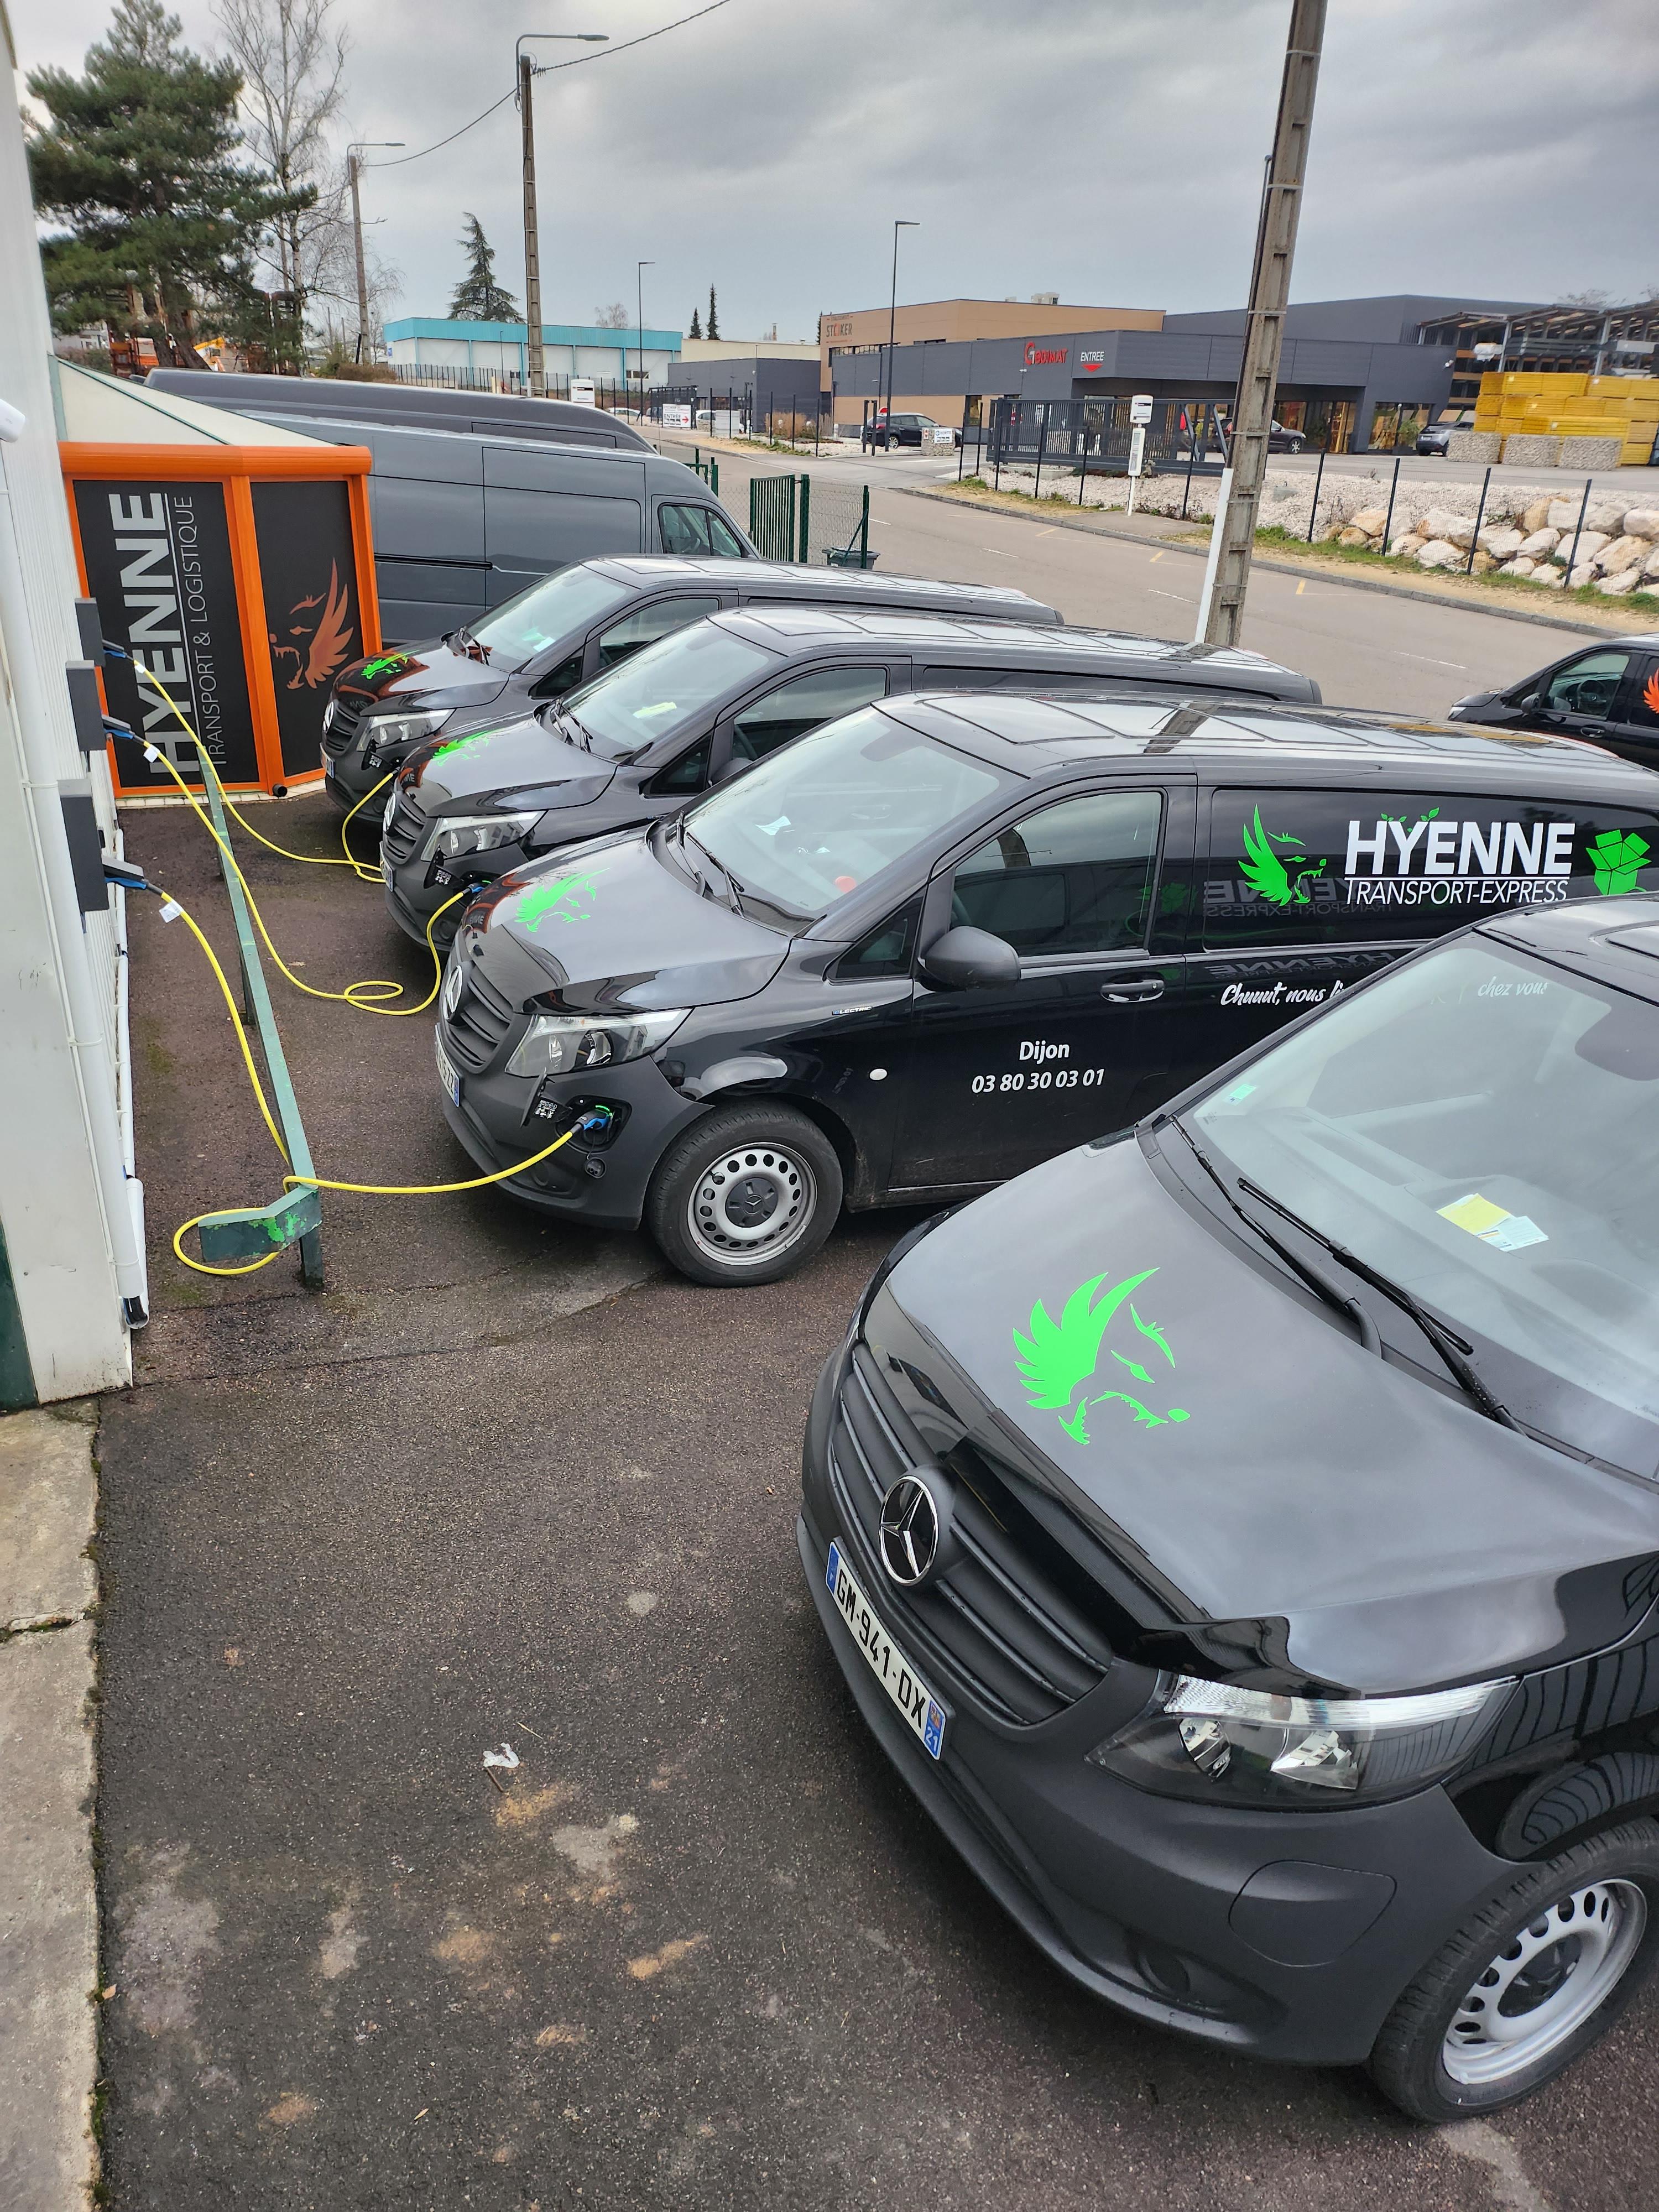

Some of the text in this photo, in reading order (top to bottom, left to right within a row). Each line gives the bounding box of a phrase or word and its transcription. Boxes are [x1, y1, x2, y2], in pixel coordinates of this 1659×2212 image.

[108, 493, 200, 774] HYENNE
[174, 496, 227, 764] TRANSPORT & LOGISTIQUE
[1344, 820, 1575, 875] HYENNE
[1345, 878, 1569, 905] TRANSPORT-EXPRESS
[1220, 982, 1287, 1006] Chuuut,
[1285, 988, 1327, 1003] nous
[1477, 975, 1513, 997] chez
[1019, 1040, 1070, 1065] Dijon
[972, 1068, 1105, 1093] 03 80 30 03 01
[836, 1568, 926, 1729] GM-941-DX
[925, 1726, 938, 1752] 21
